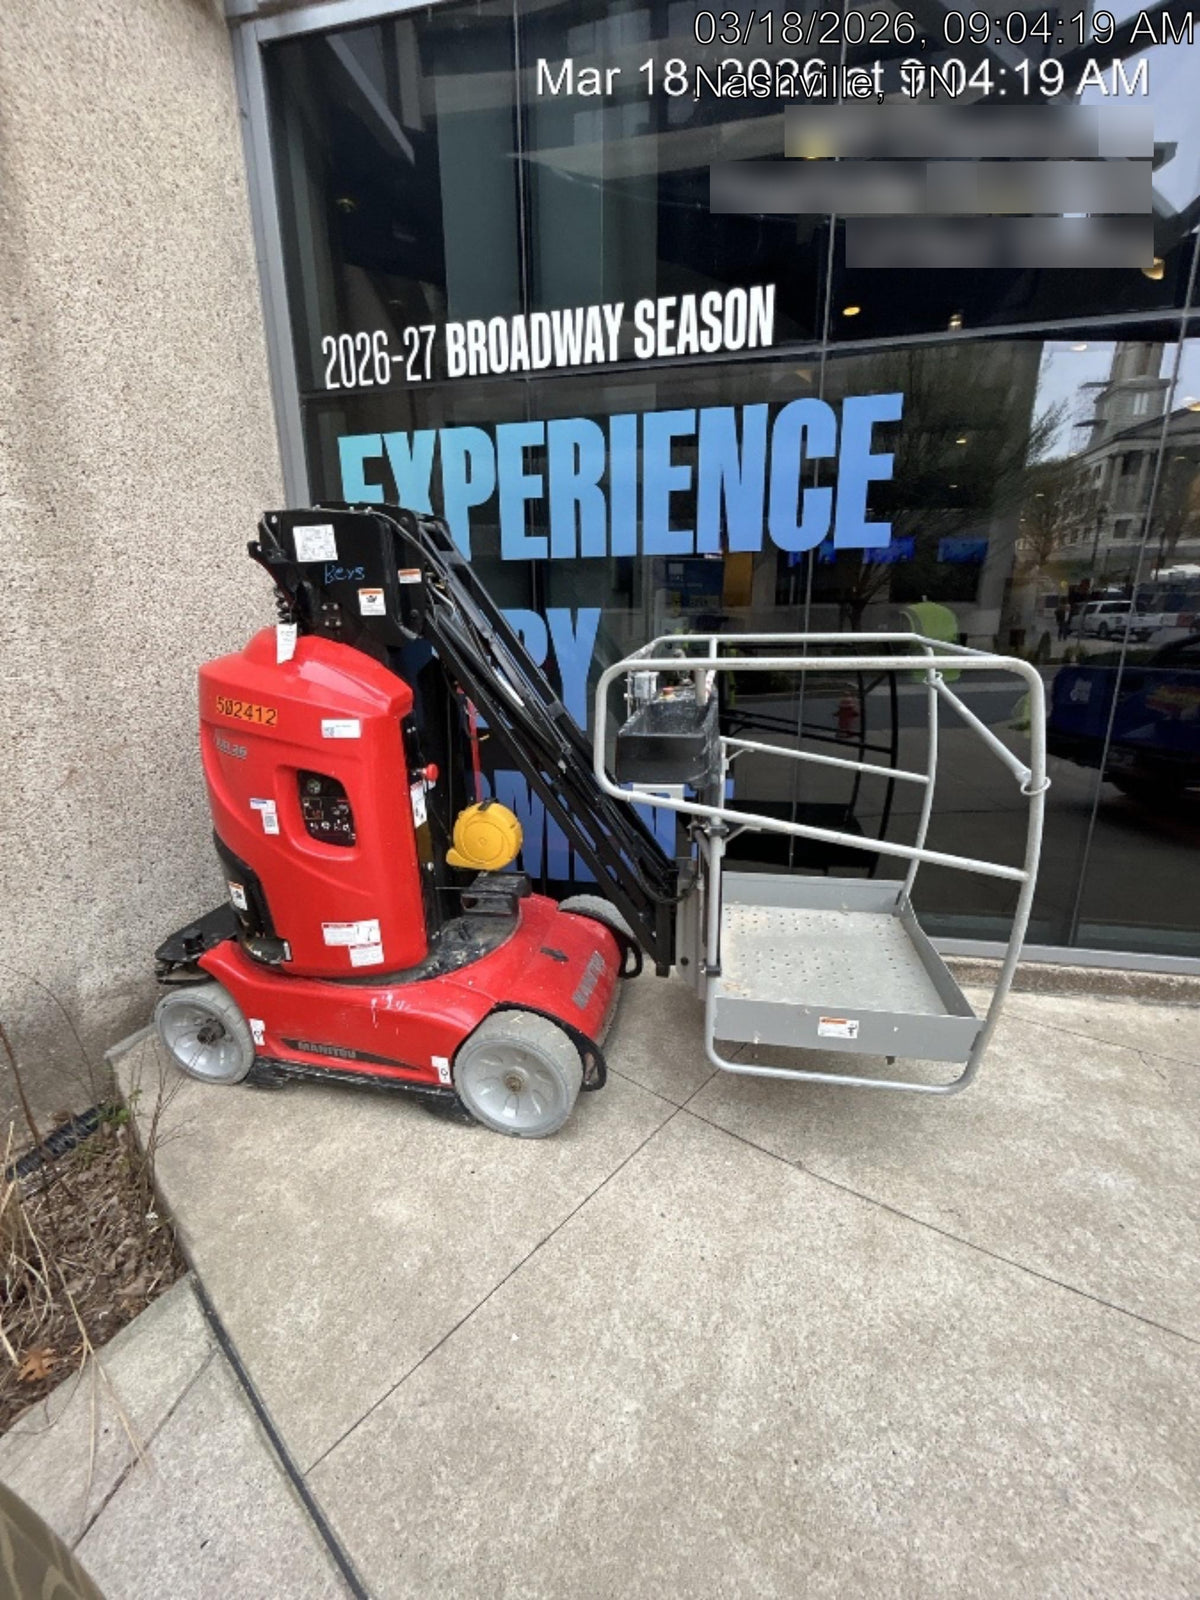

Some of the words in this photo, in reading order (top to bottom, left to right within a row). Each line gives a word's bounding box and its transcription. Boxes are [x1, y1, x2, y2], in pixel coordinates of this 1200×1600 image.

[321, 324, 436, 390] 2026-27
[445, 302, 625, 378] BROADWAY
[634, 284, 776, 359] SEASON
[337, 392, 904, 562] EXPERIENCE
[216, 696, 278, 727] 502412
[297, 1041, 358, 1059] MANITOU
